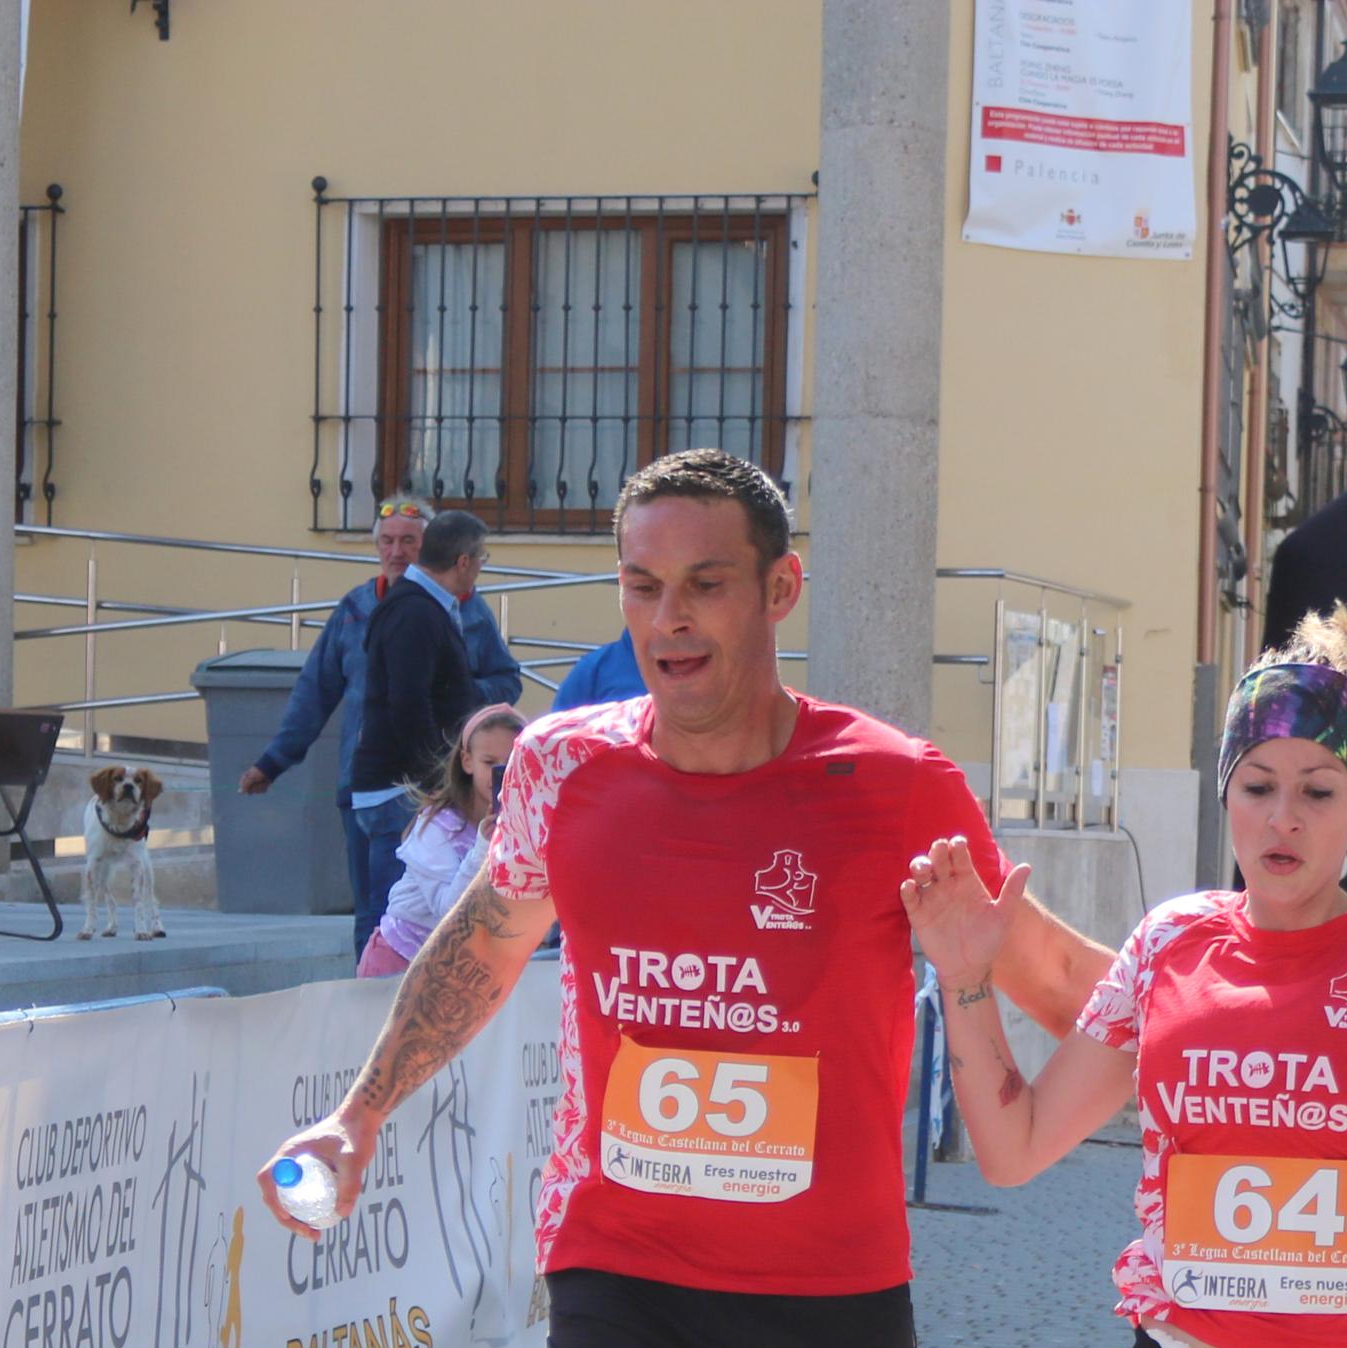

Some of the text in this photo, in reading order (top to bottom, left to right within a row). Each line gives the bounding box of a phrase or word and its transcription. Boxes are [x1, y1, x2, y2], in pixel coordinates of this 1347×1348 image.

[988, 0, 1004, 88] BALTAN
[1014, 159, 1100, 185] Palencia
[610, 946, 768, 994] TROTA
[781, 1021, 801, 1033] 3.0
[522, 1042, 548, 1087] CLUB
[1182, 1049, 1339, 1094] TROTA
[638, 1058, 769, 1137] 65
[16, 1104, 147, 1191] CLUB DEPORTIVO
[375, 1122, 404, 1191] DEL
[657, 1134, 727, 1152] Castellana
[732, 1140, 750, 1153] del
[754, 1141, 805, 1157] Cerrato
[630, 1156, 692, 1185] INTEGRA
[704, 1164, 797, 1182] Eres nuestra
[722, 1180, 780, 1197] energía
[1214, 1163, 1346, 1247] 64
[10, 1178, 138, 1288] ATLETISMO DEL
[287, 1198, 410, 1296] CERRATO
[1231, 1246, 1303, 1262] Castellana
[1307, 1250, 1326, 1264] del
[1203, 1275, 1267, 1299] INTEGRA
[1280, 1276, 1311, 1290] Eres
